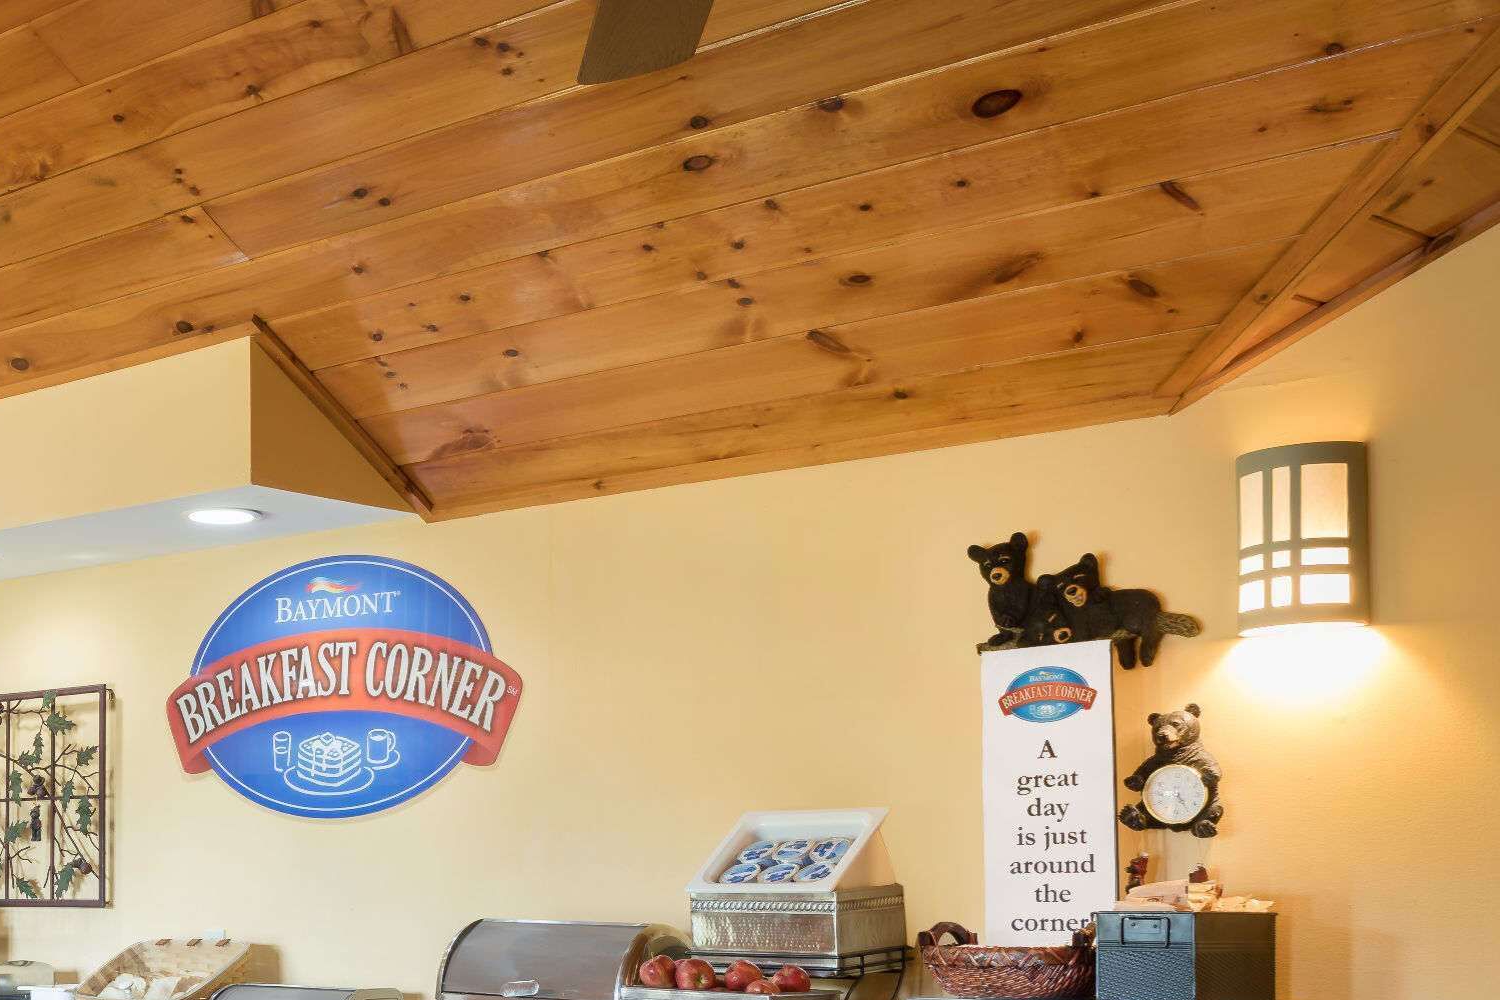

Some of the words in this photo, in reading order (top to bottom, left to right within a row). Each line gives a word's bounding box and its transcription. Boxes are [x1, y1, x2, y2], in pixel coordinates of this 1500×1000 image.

[275, 590, 398, 624] BAYMONT
[176, 641, 357, 744] BREAKFAST
[365, 641, 506, 732] CORNER
[1002, 684, 1053, 709] BREAKFAST
[1055, 684, 1094, 703] CORNER
[1037, 739, 1058, 759] A
[1016, 771, 1079, 795] great
[1027, 797, 1069, 822] day
[1016, 826, 1036, 846] is
[1044, 825, 1087, 851] just
[1009, 853, 1095, 874] around
[1034, 883, 1071, 902] the
[1011, 917, 1089, 931] corner
